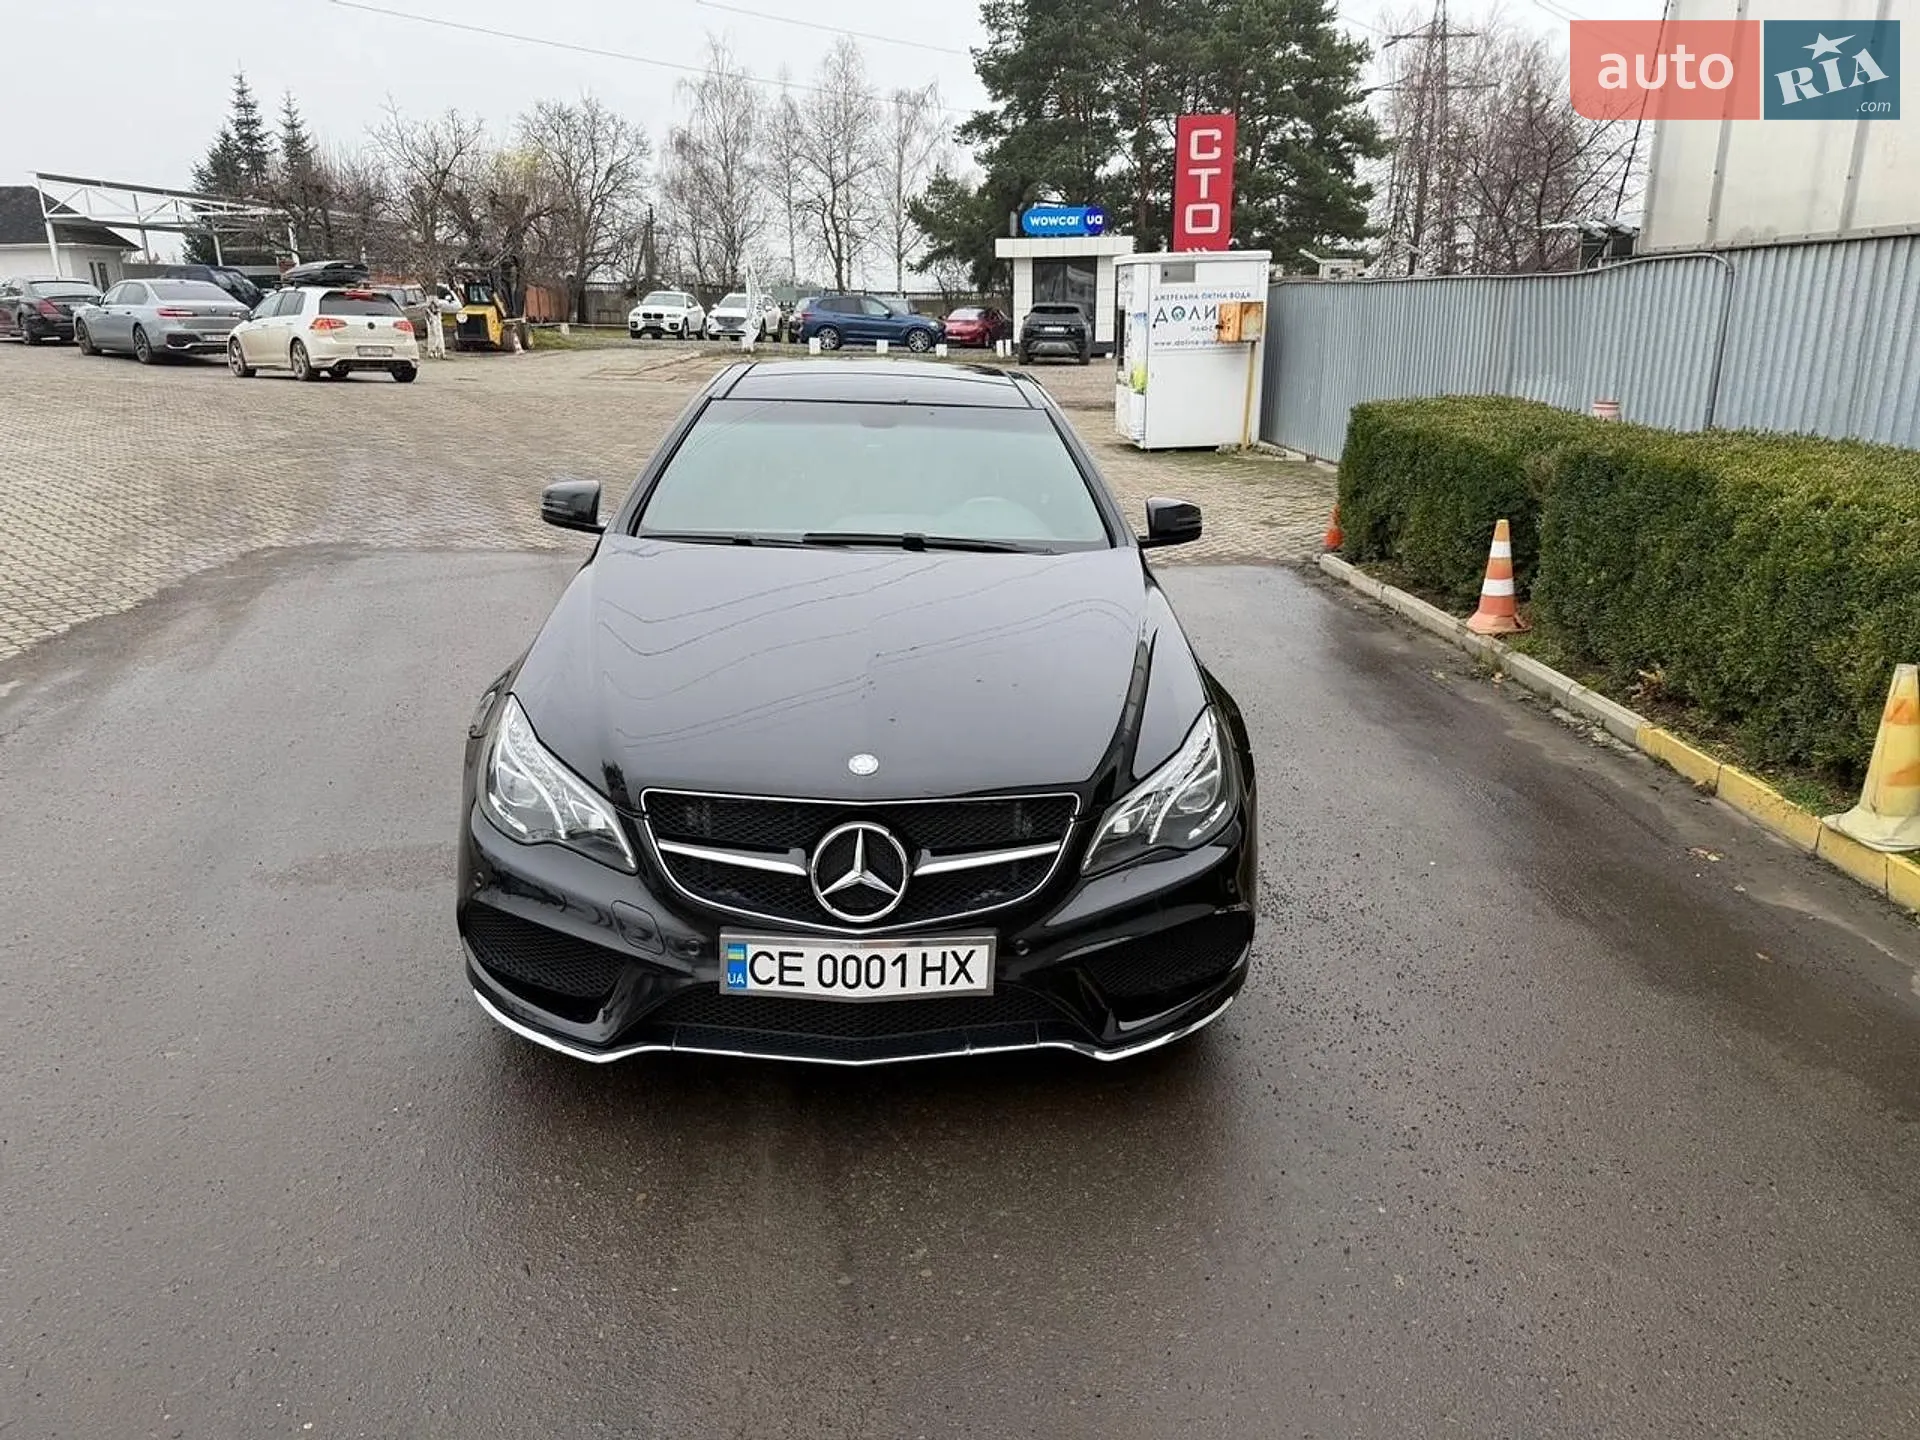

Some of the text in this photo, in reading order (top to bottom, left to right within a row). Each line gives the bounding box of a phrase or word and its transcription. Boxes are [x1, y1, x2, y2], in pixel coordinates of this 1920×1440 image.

[1185, 129, 1222, 234] СТО
[1029, 214, 1104, 226] wowcar ua
[1153, 305, 1217, 325] ДОЛИ
[728, 972, 745, 985] UA
[749, 949, 976, 990] CE 0001 HX
